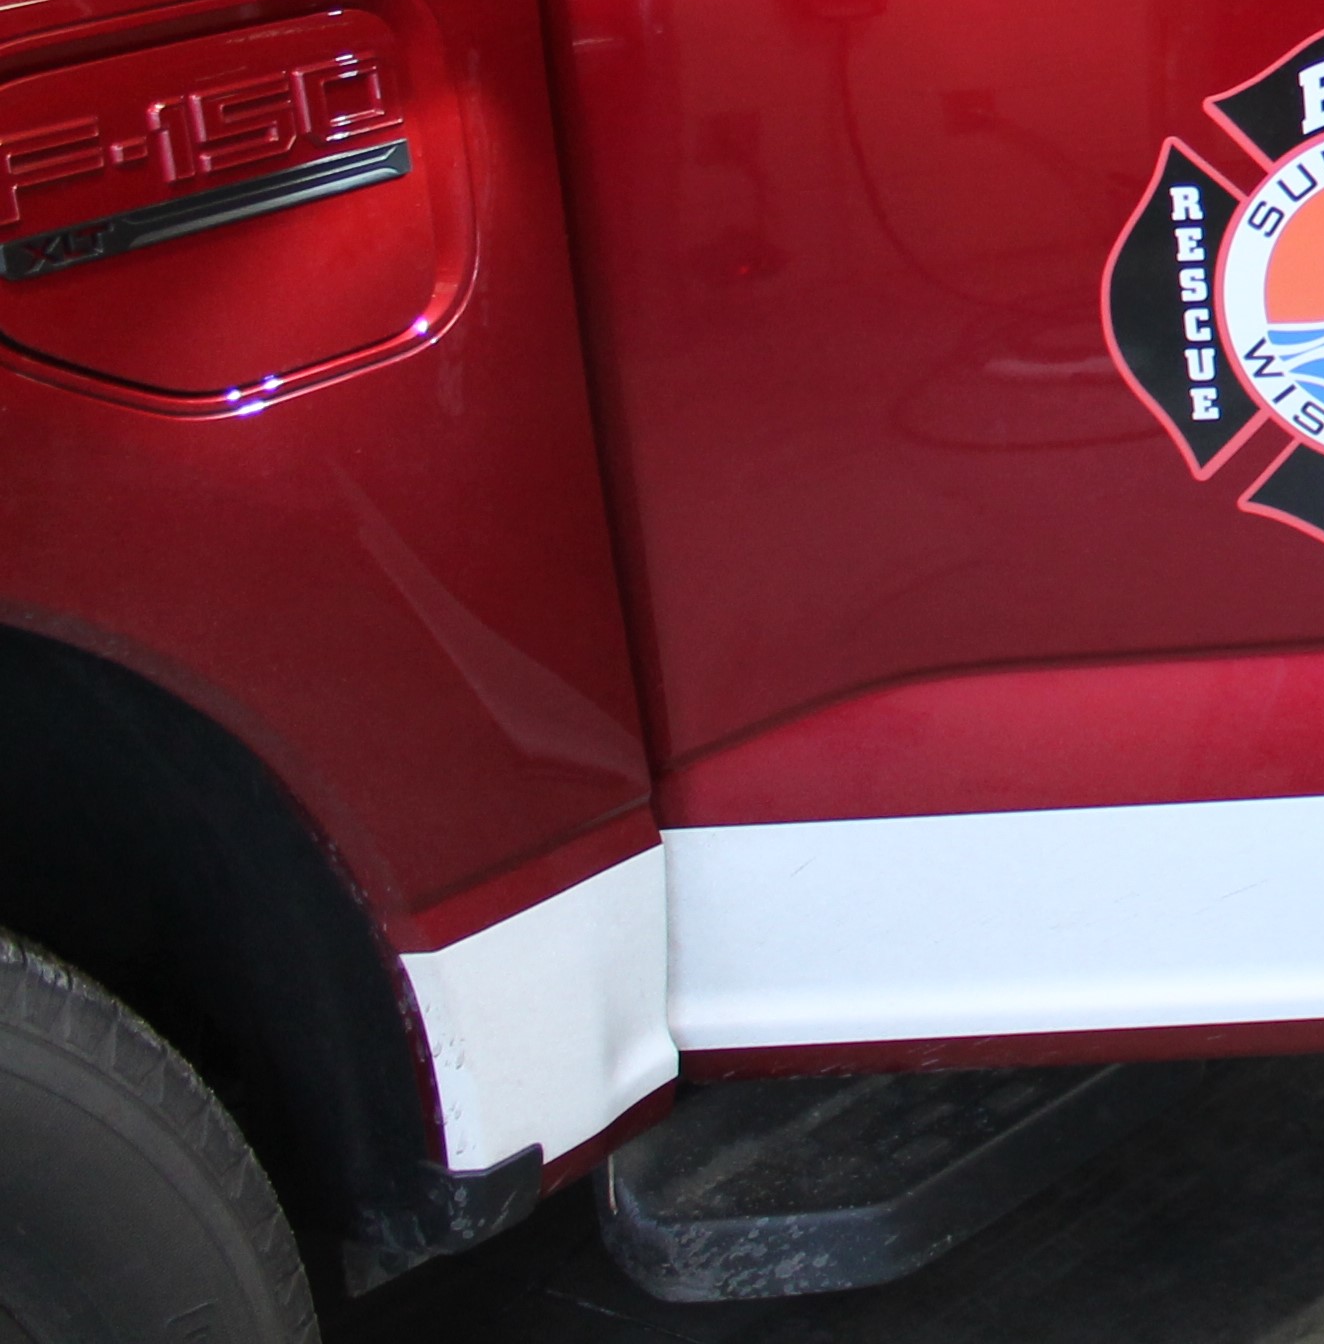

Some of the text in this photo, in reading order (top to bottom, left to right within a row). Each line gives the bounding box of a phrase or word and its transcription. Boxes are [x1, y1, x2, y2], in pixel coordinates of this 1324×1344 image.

[0, 52, 404, 225] F-150
[23, 221, 115, 275] XLT
[1169, 186, 1220, 421] RESCUE
